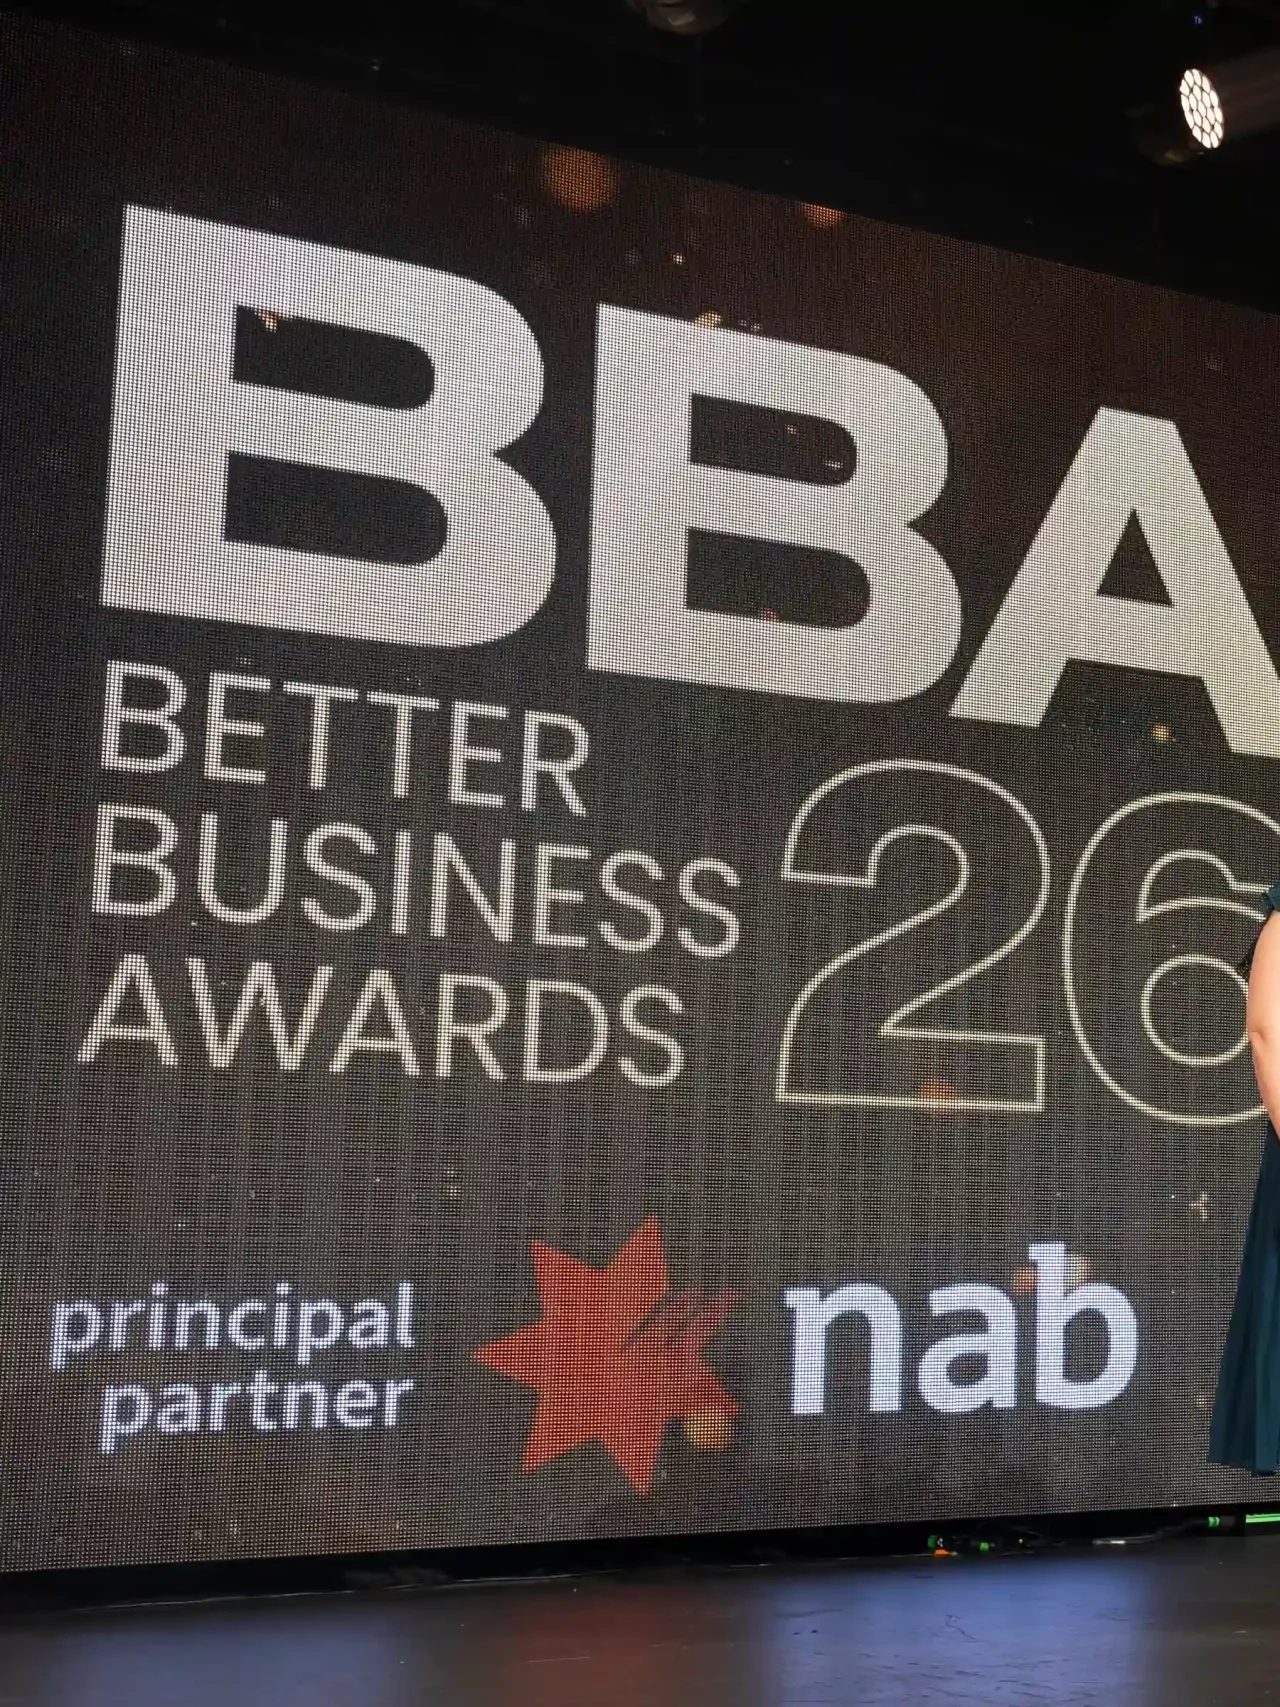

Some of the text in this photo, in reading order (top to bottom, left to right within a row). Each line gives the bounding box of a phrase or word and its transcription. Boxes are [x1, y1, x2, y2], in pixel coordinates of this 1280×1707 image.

[99, 660, 590, 816] BETTER
[91, 803, 741, 959] BUSINESS
[76, 952, 685, 1088] AWARDS
[49, 1282, 415, 1371] principal
[783, 1240, 1140, 1415] nab
[100, 1369, 416, 1454] partner
